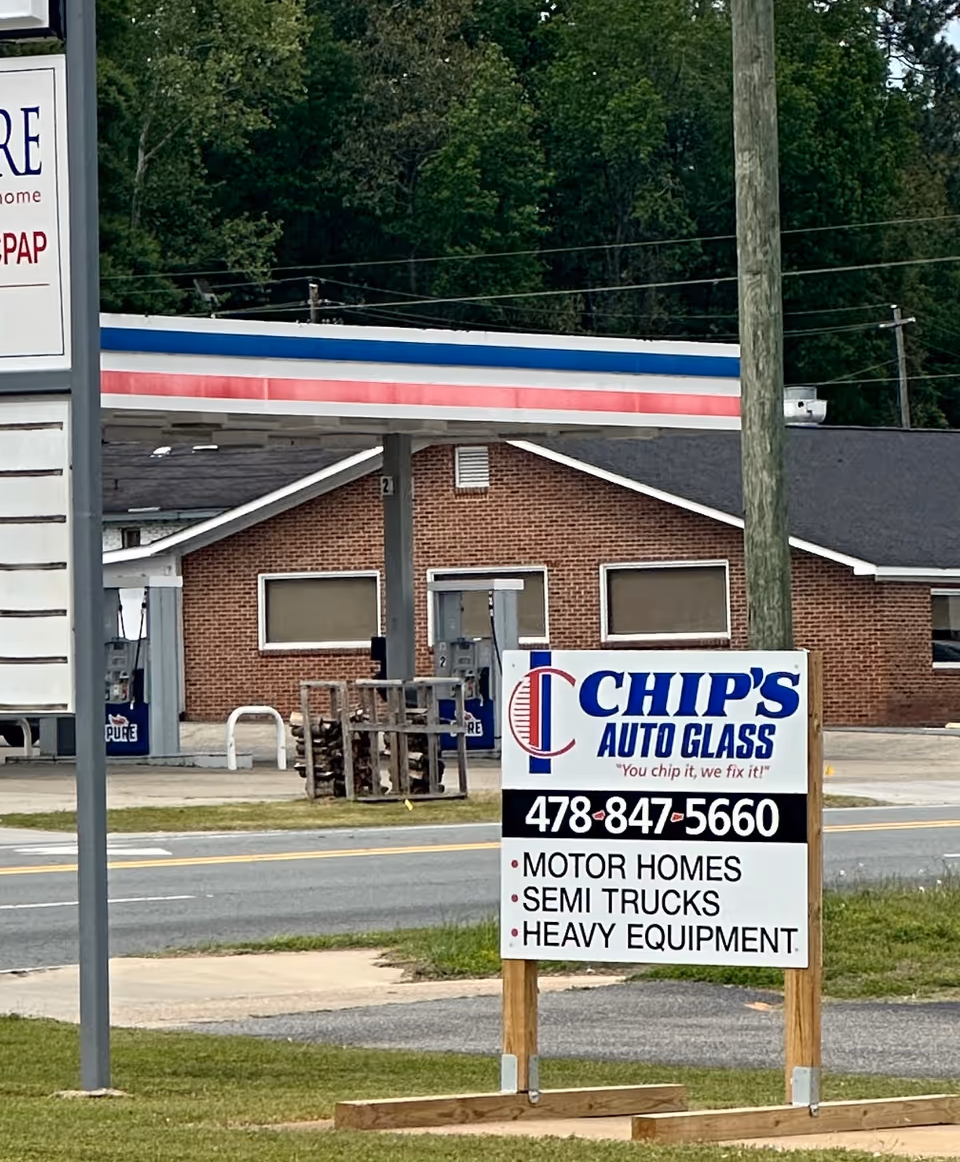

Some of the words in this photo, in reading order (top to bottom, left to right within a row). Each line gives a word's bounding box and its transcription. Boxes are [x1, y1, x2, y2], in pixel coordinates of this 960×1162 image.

[578, 667, 800, 718] CHIP'S
[105, 724, 137, 742] PURE
[597, 723, 675, 758] AUTO
[680, 723, 776, 760] GLASS
[616, 763, 647, 778] "You
[651, 764, 680, 781] chip
[684, 764, 697, 780] it,
[701, 768, 722, 778] we
[726, 764, 744, 778] fix
[748, 764, 770, 779] it!"
[525, 795, 779, 837] 478-847-5660
[523, 852, 626, 880] MOTOR
[637, 854, 742, 882] HOMES
[523, 886, 590, 913] SEMI
[602, 888, 720, 917] TRUCKS
[523, 921, 616, 948] HEAVY
[627, 924, 798, 955] EQUIPMENT
